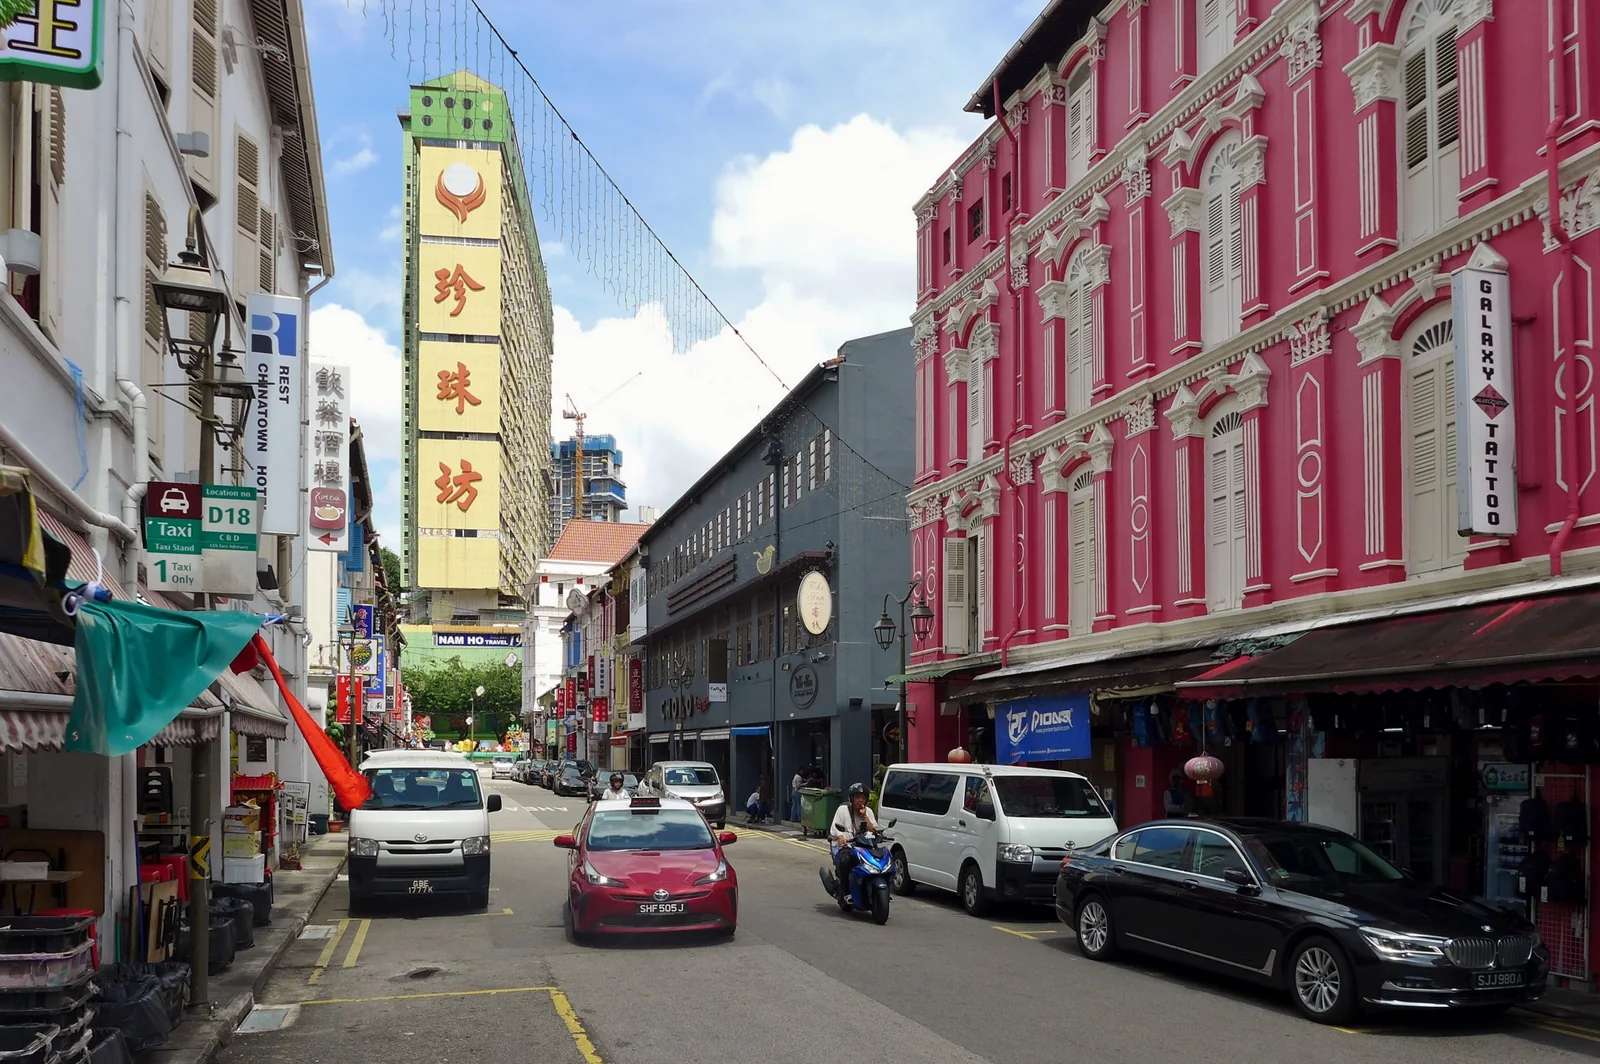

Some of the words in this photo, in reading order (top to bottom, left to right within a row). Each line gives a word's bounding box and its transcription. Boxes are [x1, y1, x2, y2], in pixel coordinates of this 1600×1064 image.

[1480, 279, 1495, 381] GALAXY
[279, 365, 290, 404] REST
[434, 264, 486, 513] 珍珠坊
[257, 363, 268, 452] CHINATOWN
[1485, 423, 1500, 526] TATTOO
[206, 488, 239, 497] Location
[256, 465, 268, 510] HOT
[208, 506, 251, 526] D18
[157, 521, 192, 538] Taxi
[173, 543, 195, 552] Stand
[154, 559, 167, 583] 1
[172, 562, 192, 572] Taxi
[172, 574, 194, 585] Only
[438, 635, 464, 645] NAM
[467, 636, 484, 645] HO
[408, 886, 434, 894] 1777K
[412, 879, 429, 887] GBE
